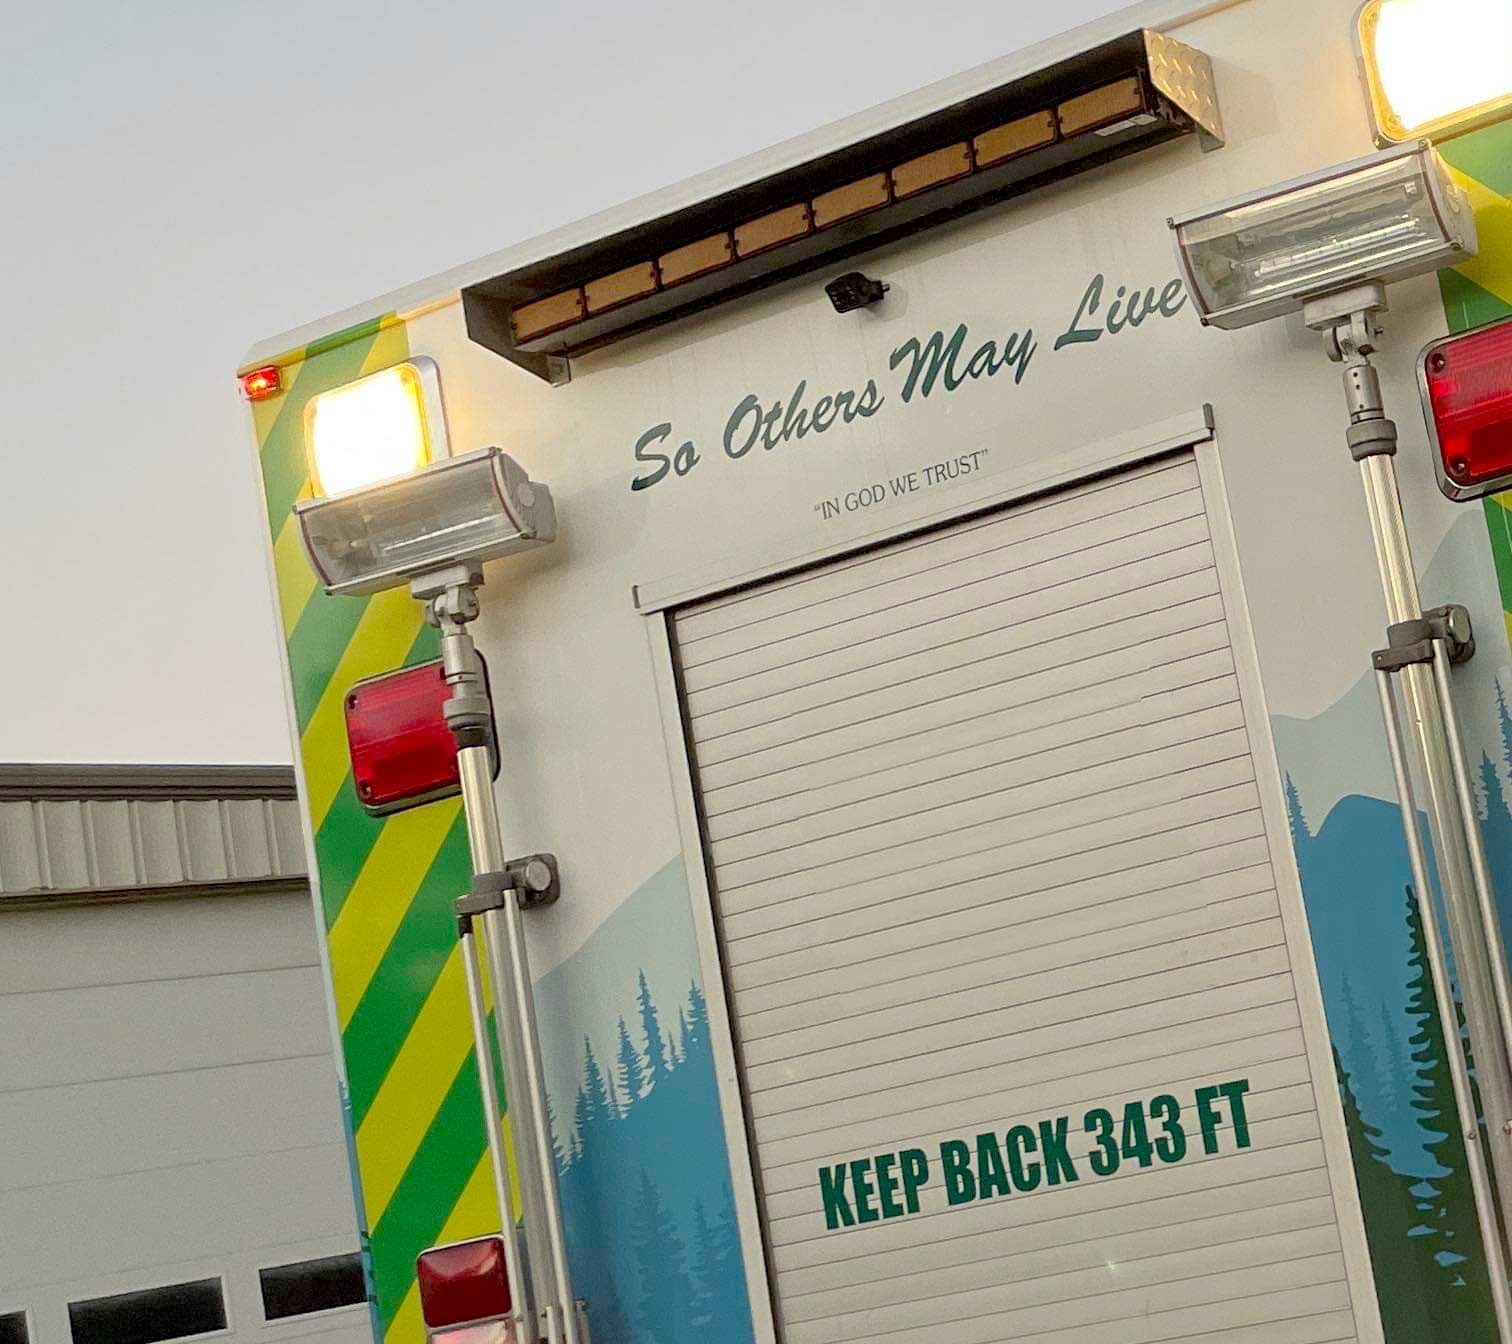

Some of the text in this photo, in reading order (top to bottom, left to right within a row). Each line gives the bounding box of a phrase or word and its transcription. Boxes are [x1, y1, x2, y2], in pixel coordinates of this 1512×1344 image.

[631, 273, 1187, 492] So Others May Live
[845, 484, 886, 512] GOD
[889, 472, 921, 497] WE
[818, 1078, 1251, 1231] KEEP BACK 343 FT
